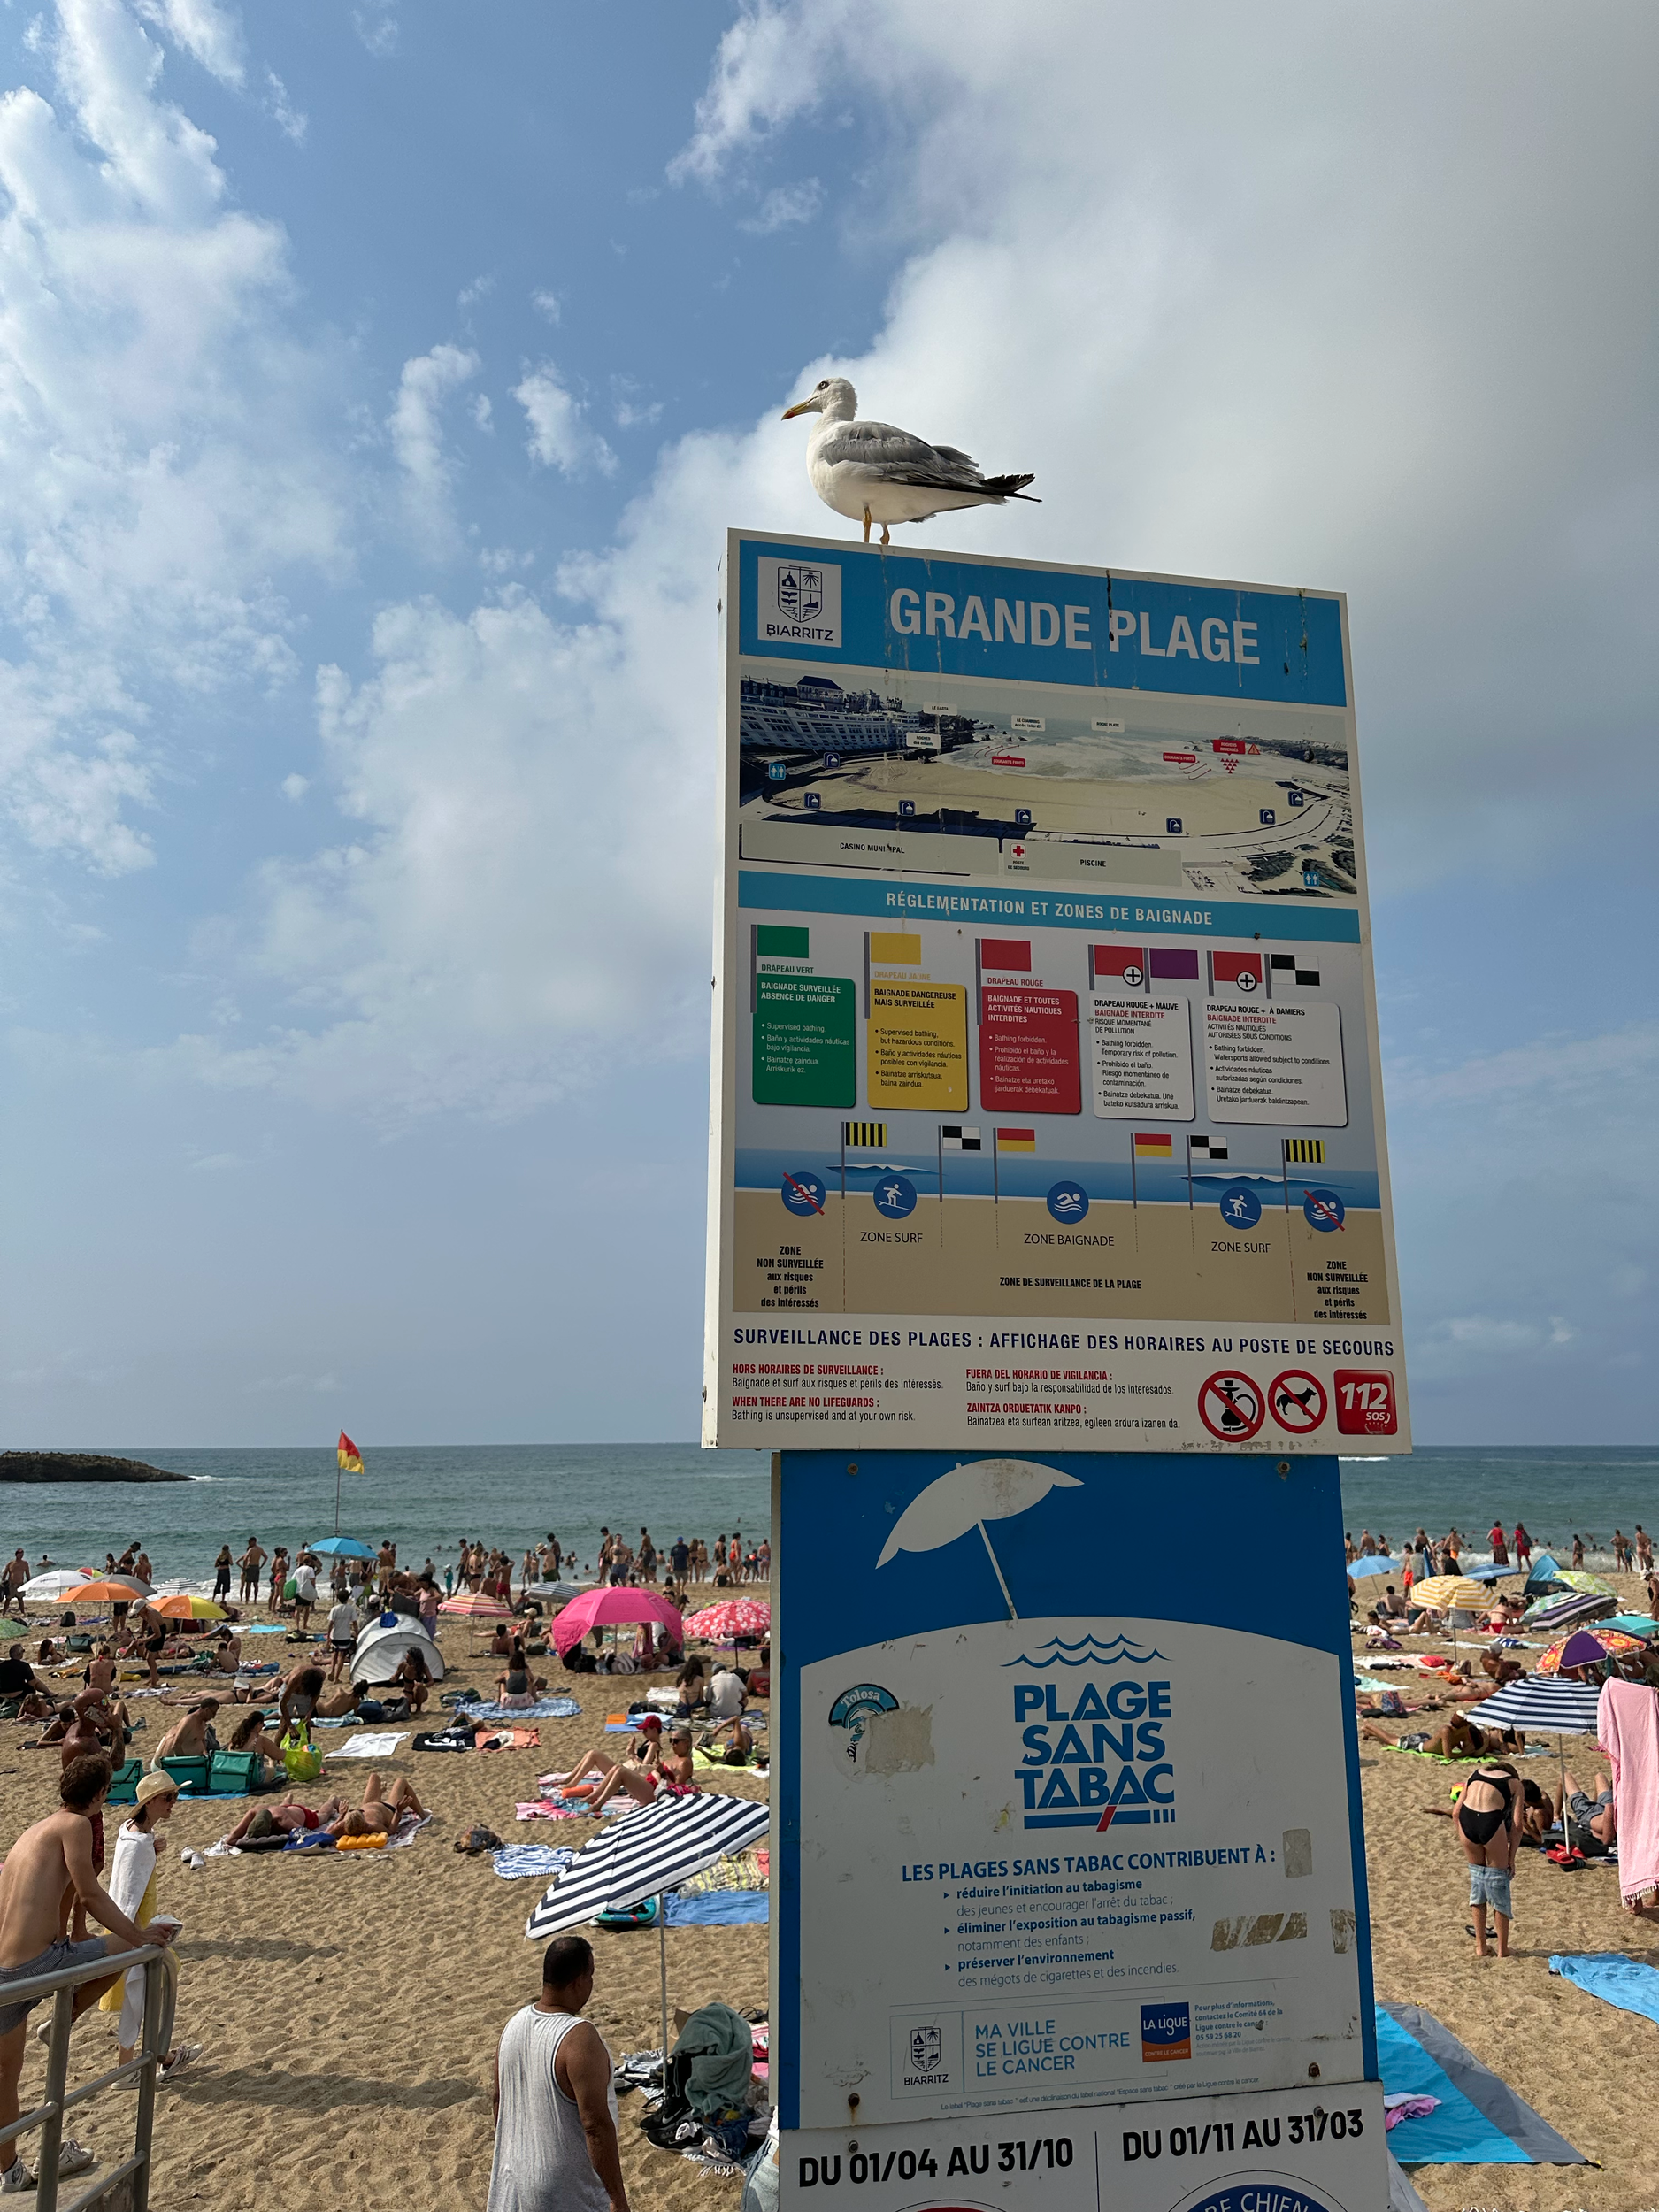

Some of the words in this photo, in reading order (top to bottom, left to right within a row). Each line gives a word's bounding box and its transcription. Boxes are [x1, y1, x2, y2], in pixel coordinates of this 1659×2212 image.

[766, 623, 833, 640] BIARRITZ
[890, 588, 1091, 650] GRANDE
[1110, 611, 1260, 664] PLAGE
[887, 891, 1024, 915] RÉGLEMENTATION
[1031, 901, 1048, 915] ET
[1055, 903, 1103, 919] ZONES
[1110, 906, 1129, 920] DE
[1135, 908, 1212, 924] BAIGNADE
[761, 964, 794, 972] DRAPEAU
[761, 982, 797, 990] BAIGNADE
[799, 984, 840, 993] SURVEILLÉE
[987, 977, 1020, 986] DRAPEAU
[1020, 978, 1043, 987] ROUGE
[761, 992, 796, 1001] ABSENCE
[795, 993, 806, 1002] DE
[806, 994, 835, 1003] DANGER
[874, 988, 911, 998] BAIGNADE
[911, 990, 956, 1000] DANGEREUSE
[988, 994, 1024, 1004] BAIGNADE
[1033, 997, 1059, 1005] TOUTES
[874, 999, 893, 1007] MAIS
[893, 999, 935, 1008] SURVEILLÉE
[988, 1004, 1024, 1013] ACTIVITÉS
[1024, 1006, 1062, 1015] NAUTIQUES
[988, 1014, 1028, 1023] INTERDITES
[1095, 1009, 1130, 1018] BAIGNADE
[1130, 1010, 1165, 1019] INTERDITE
[1207, 1014, 1242, 1023] BAIGNADE
[1242, 1015, 1277, 1024] INTERDITE
[1207, 1023, 1236, 1031] ACTIVITÉS
[860, 1232, 891, 1242] ZONE
[895, 1232, 922, 1243] SURF
[1024, 1233, 1054, 1244] ZONE
[1057, 1234, 1114, 1246] BAIGNADE
[779, 1246, 801, 1255] ZONE
[757, 1258, 774, 1267] NON
[777, 1258, 823, 1268] SURVEILLÉE
[783, 1272, 813, 1282] risques
[1000, 1277, 1020, 1286] ZONE
[1022, 1277, 1032, 1286] DE
[1034, 1277, 1091, 1287] SURVEILLANCE
[1093, 1279, 1103, 1288] DE
[1104, 1279, 1114, 1288] LA
[1116, 1280, 1141, 1289] PLAGE
[773, 1285, 781, 1294] et
[784, 1284, 806, 1295] périls
[761, 1297, 775, 1306] des
[777, 1297, 819, 1307] intéressés
[734, 1328, 861, 1345] SURVEILLANCE
[869, 1331, 900, 1345] DES
[908, 1331, 970, 1347] PLAGES
[990, 1333, 1080, 1349] AFFICHAGE
[1087, 1335, 1117, 1349] DES
[1124, 1336, 1204, 1351] HORAIRES
[1212, 1338, 1232, 1352] AU
[1239, 1338, 1289, 1353] POSTE
[1296, 1339, 1316, 1354] DE
[1322, 1340, 1393, 1355] SECOURS
[732, 1377, 769, 1389] Baignade
[772, 1377, 780, 1387] et
[783, 1377, 798, 1387] surf
[801, 1379, 815, 1387] aux
[818, 1379, 847, 1389] risques
[849, 1378, 857, 1388] et
[860, 1378, 882, 1390] périls
[884, 1378, 898, 1388] des
[901, 1378, 943, 1389] intéressés.
[1341, 1382, 1389, 1410] 112
[732, 1410, 762, 1422] Bathing
[765, 1412, 772, 1420] is
[775, 1410, 828, 1422] unsupervised
[831, 1410, 846, 1420] and
[849, 1411, 856, 1420] at
[859, 1412, 877, 1422] your
[898, 1411, 915, 1420] risk.
[1366, 1412, 1385, 1421] SOS
[840, 1689, 880, 1708] Tolosa
[1014, 1681, 1172, 1722] PLAGE
[1022, 1721, 1166, 1766] SANS
[1014, 1764, 1175, 1809] TABAC
[902, 1864, 933, 1881] LES
[938, 1860, 1008, 1879] PLAGES
[1013, 1857, 1060, 1876] SANS
[1064, 1854, 1123, 1873] TABAC
[1128, 1847, 1250, 1869] CONTRIBUENT
[1254, 1847, 1266, 1862] À
[957, 1886, 999, 1899] réduire
[1066, 1884, 1079, 1892] au
[1082, 1879, 1142, 1893] tabagisme
[957, 1921, 1006, 1934] éliminer
[1080, 1918, 1094, 1926] au
[1097, 1912, 1156, 1926] tabagisme
[1160, 1908, 1195, 1924] passif,
[958, 1957, 1015, 1972] préserver
[975, 2023, 1002, 2039] MA
[1007, 2019, 1055, 2037] VILLE
[975, 2042, 996, 2058] SE
[1003, 2038, 1053, 2056] LIGUE
[1059, 2033, 1130, 2051] CONTRE
[976, 2060, 997, 2076] LE
[1002, 2056, 1074, 2074] CANCER
[904, 2073, 948, 2085] BIARRITZ
[1122, 2129, 1161, 2161] DU
[1169, 2122, 1234, 2156] 01/11
[1242, 2117, 1280, 2149] AU
[1288, 2109, 1363, 2144] 31/03
[799, 2155, 840, 2187] DU
[849, 2148, 938, 2184] 01/04
[946, 2144, 989, 2176] AU
[998, 2137, 1073, 2172] 31/10
